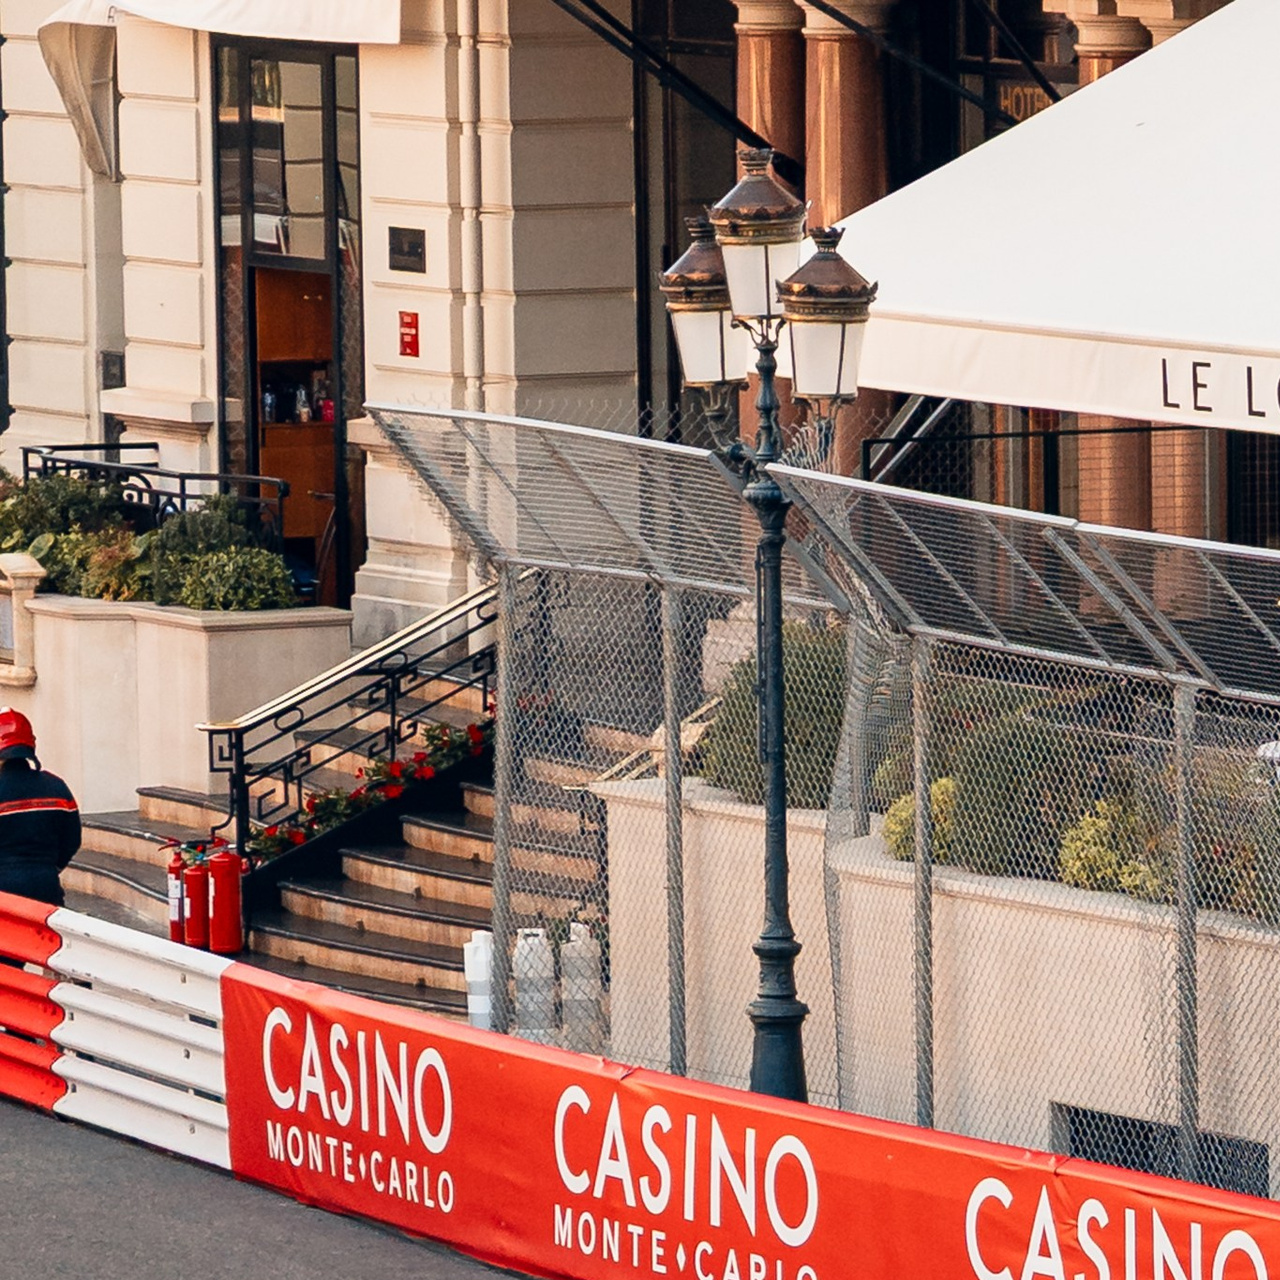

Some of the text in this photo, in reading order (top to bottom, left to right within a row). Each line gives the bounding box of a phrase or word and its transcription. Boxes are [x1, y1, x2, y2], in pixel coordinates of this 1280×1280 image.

[1161, 358, 1213, 413] LE
[262, 1007, 453, 1154] CASINO
[554, 1085, 819, 1247] CASINO
